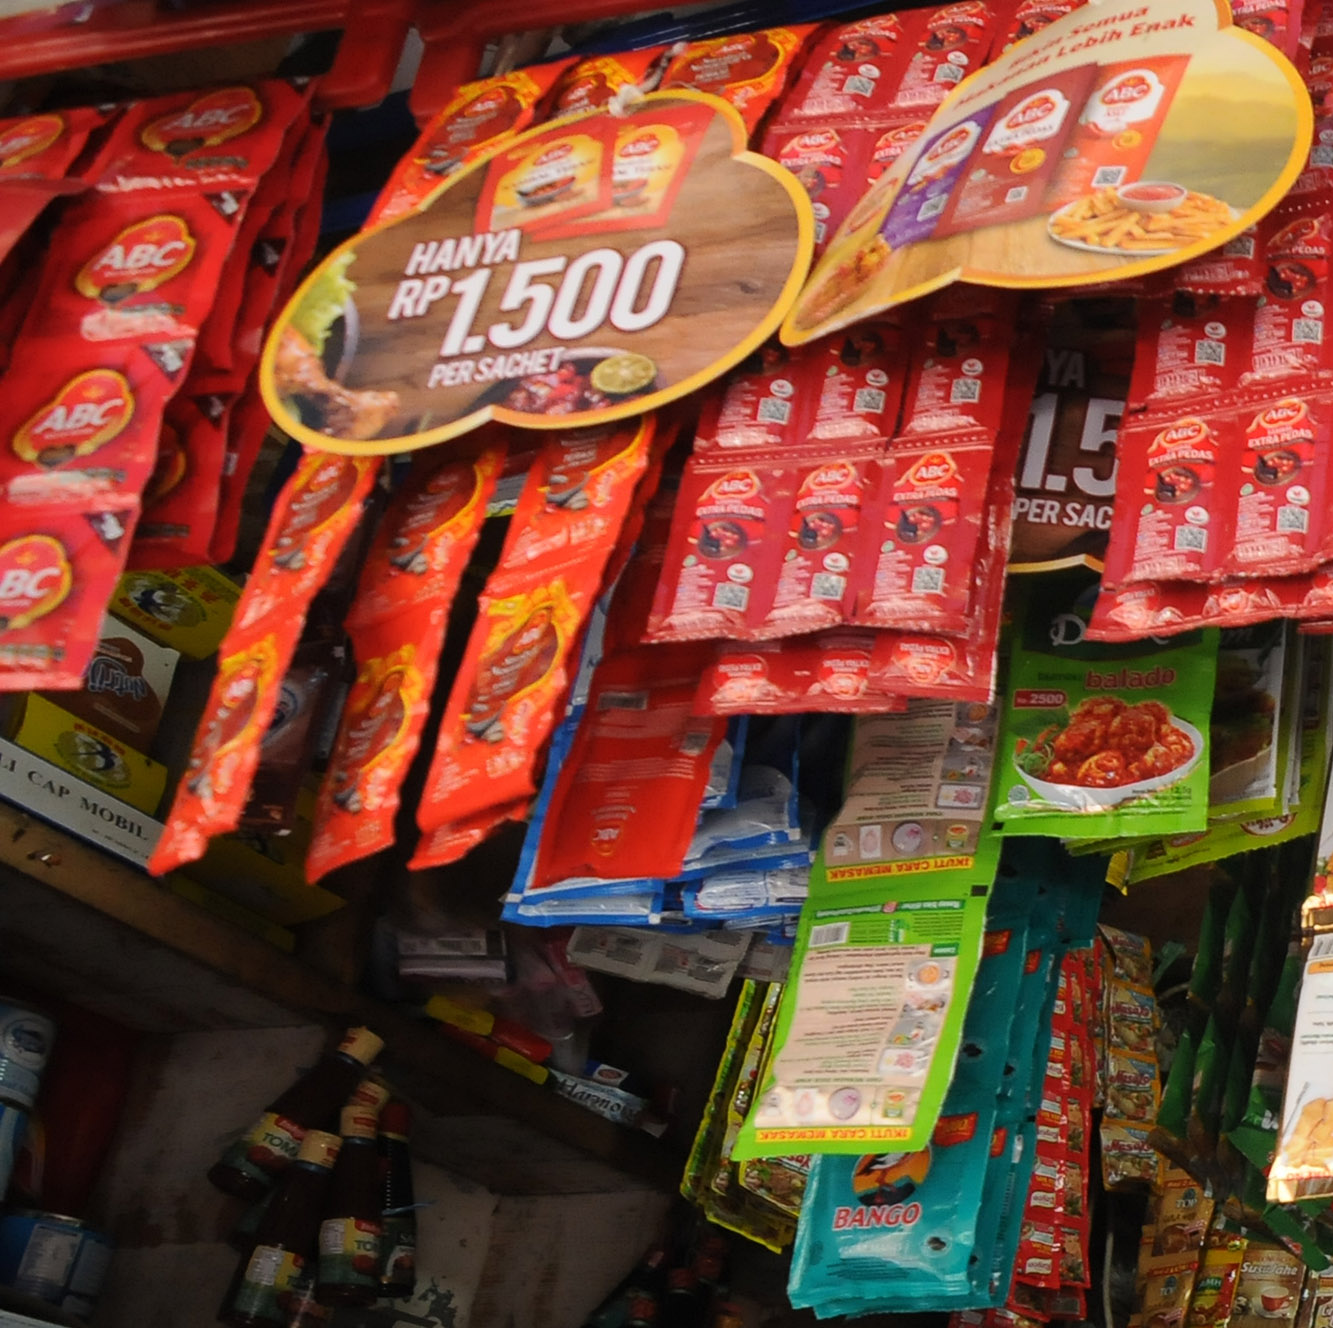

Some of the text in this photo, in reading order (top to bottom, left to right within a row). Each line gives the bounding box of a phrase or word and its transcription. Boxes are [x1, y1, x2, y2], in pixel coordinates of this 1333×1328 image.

[1057, 14, 1196, 57] Lebih Enak
[1105, 83, 1148, 101] ABC
[92, 241, 187, 270] ABC
[405, 229, 523, 276] HANYA
[387, 239, 685, 358] RP 1.500
[428, 346, 565, 389] PER SACHET
[40, 398, 125, 430] ABC
[1265, 406, 1302, 423] ABC
[1164, 425, 1199, 443] ABC
[1247, 429, 1314, 448] EXTRA PEDAS
[814, 468, 848, 487] ABC
[915, 463, 949, 481] ABC
[716, 476, 751, 495] ABC
[1010, 498, 1058, 525] PER
[0, 566, 62, 599] BC
[1084, 667, 1176, 691] balado
[1030, 692, 1064, 705] 2500
[27, 768, 150, 842] CAP MOBIL
[830, 857, 970, 880] IKUTI CARA MEMASAK
[759, 1129, 909, 1141] IKUTI CARA MEMASAK
[832, 1202, 923, 1231] BANGO
[1241, 1262, 1299, 1276] Susu Jahe
